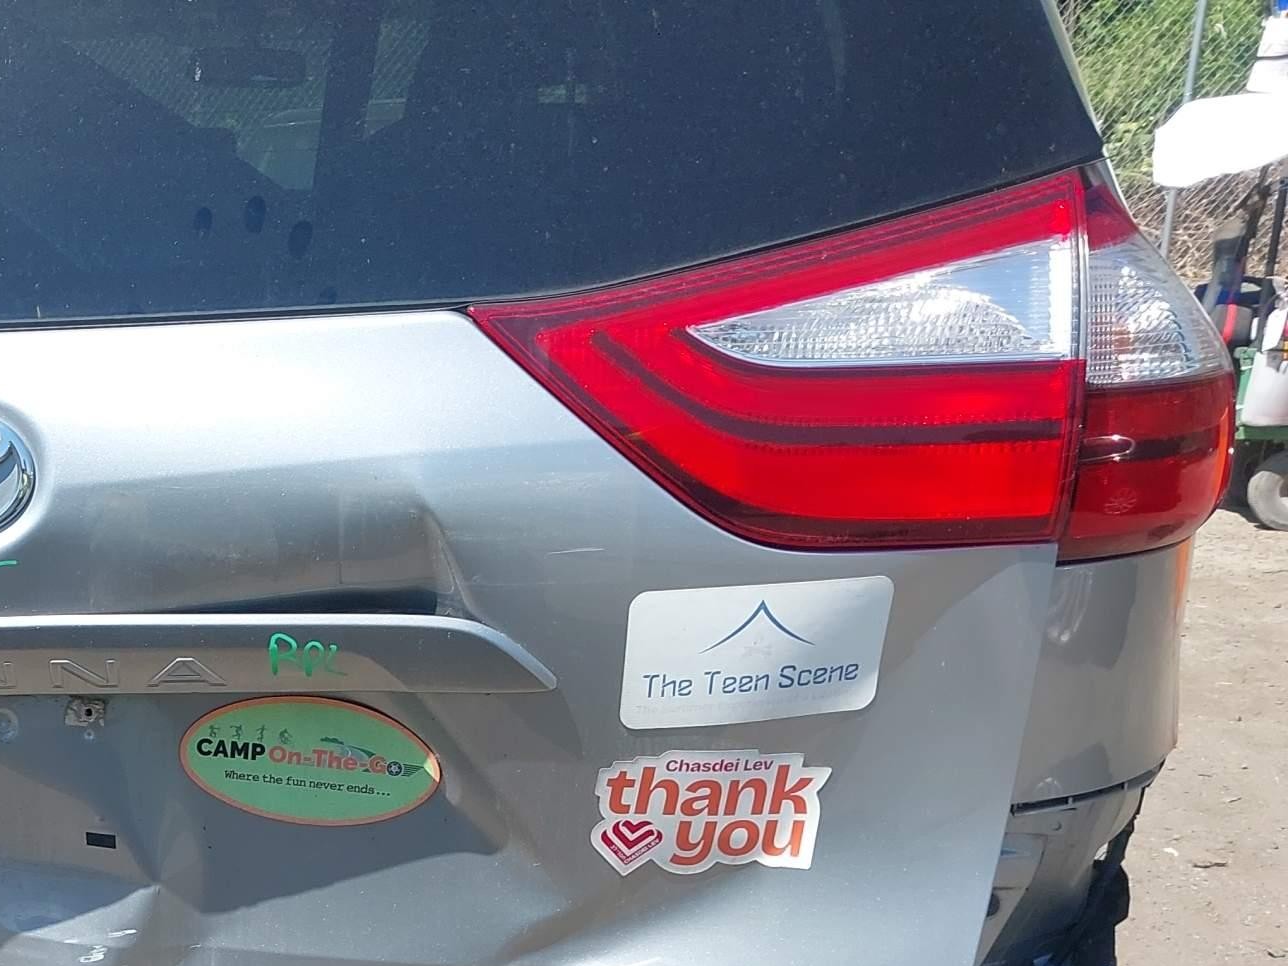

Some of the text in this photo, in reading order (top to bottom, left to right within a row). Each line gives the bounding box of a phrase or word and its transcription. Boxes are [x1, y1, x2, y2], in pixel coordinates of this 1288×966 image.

[642, 673, 694, 699] The
[703, 670, 770, 695] Teen
[778, 662, 860, 688] Scene
[196, 737, 267, 761] CAMP
[665, 758, 774, 773] Chasdei Lev
[224, 769, 391, 797] Where the fun never ends...
[606, 763, 816, 817] thank
[669, 818, 806, 866] you
